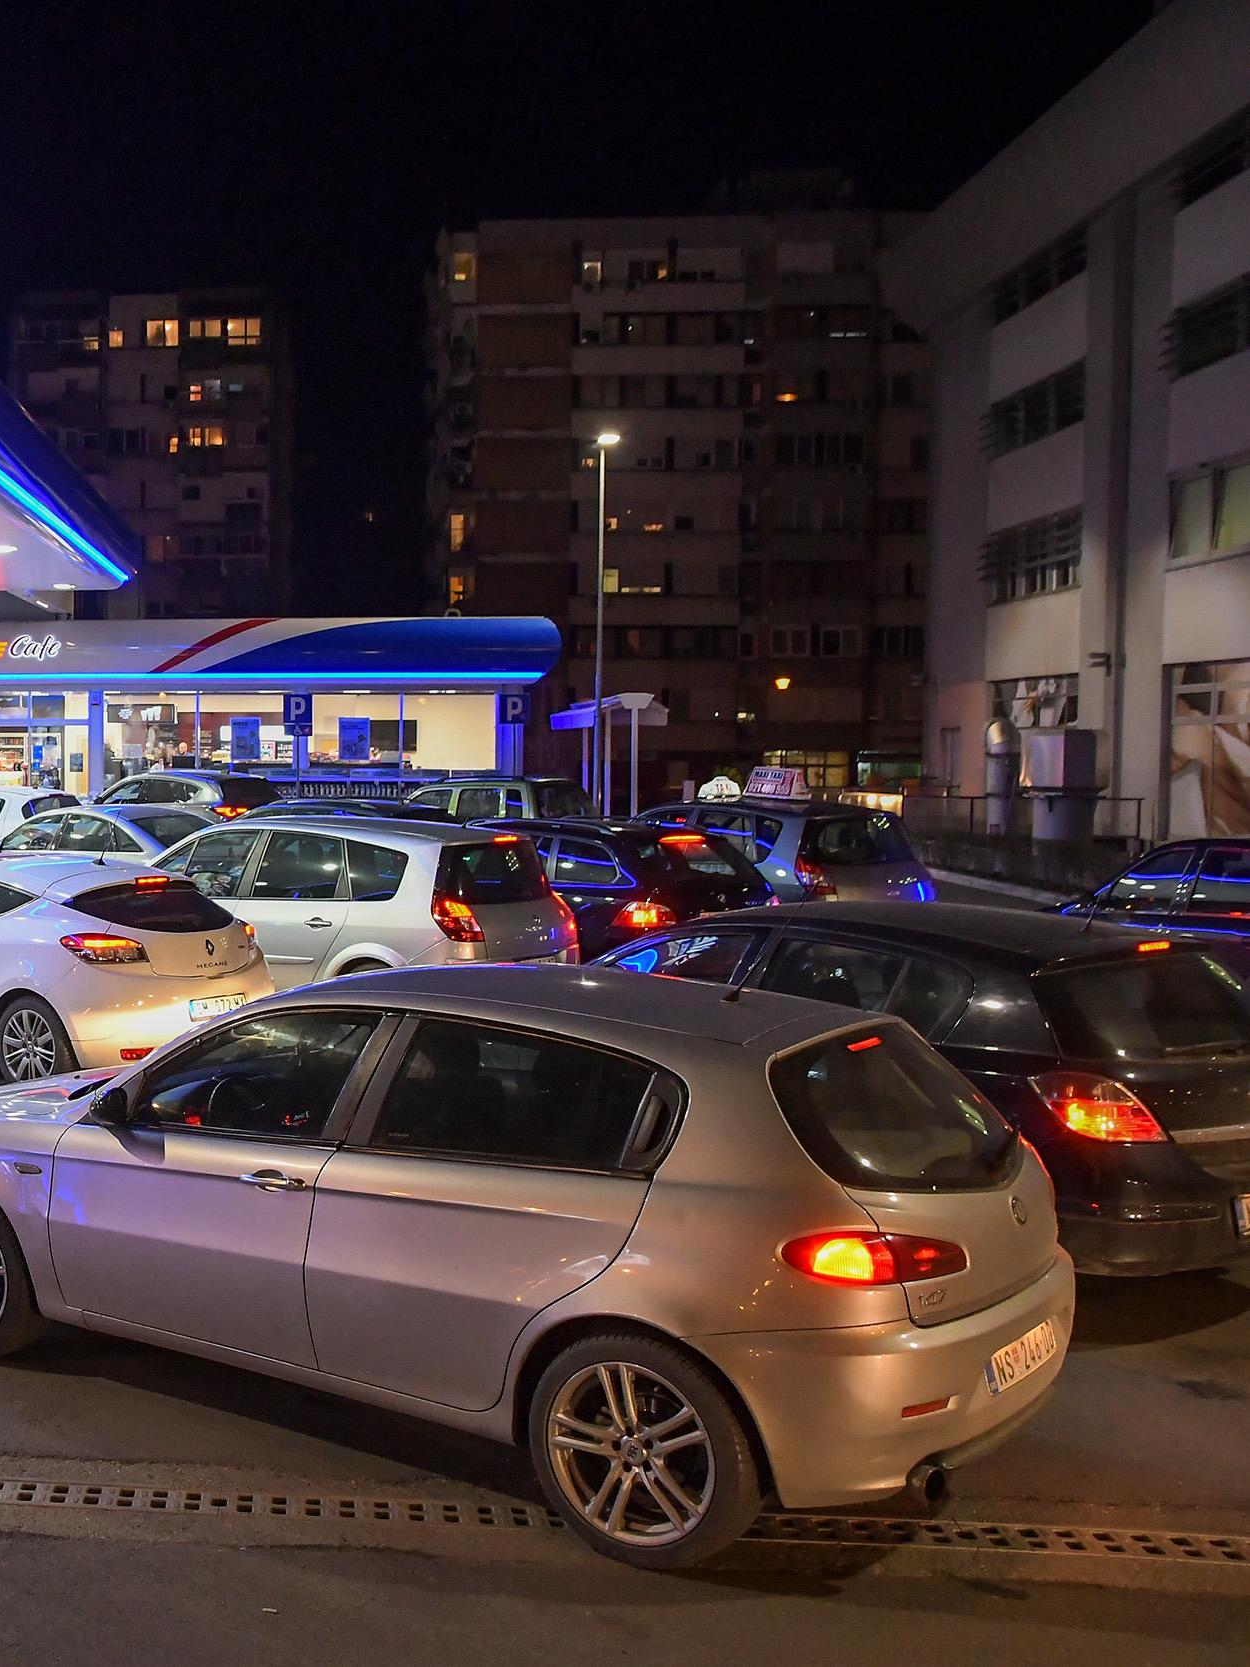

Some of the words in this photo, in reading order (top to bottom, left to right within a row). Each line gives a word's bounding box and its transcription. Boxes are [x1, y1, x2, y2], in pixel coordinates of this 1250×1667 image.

[290, 697, 306, 721] P
[507, 696, 523, 721] P
[196, 961, 228, 969] MEGANE
[994, 1350, 1015, 1386] NS
